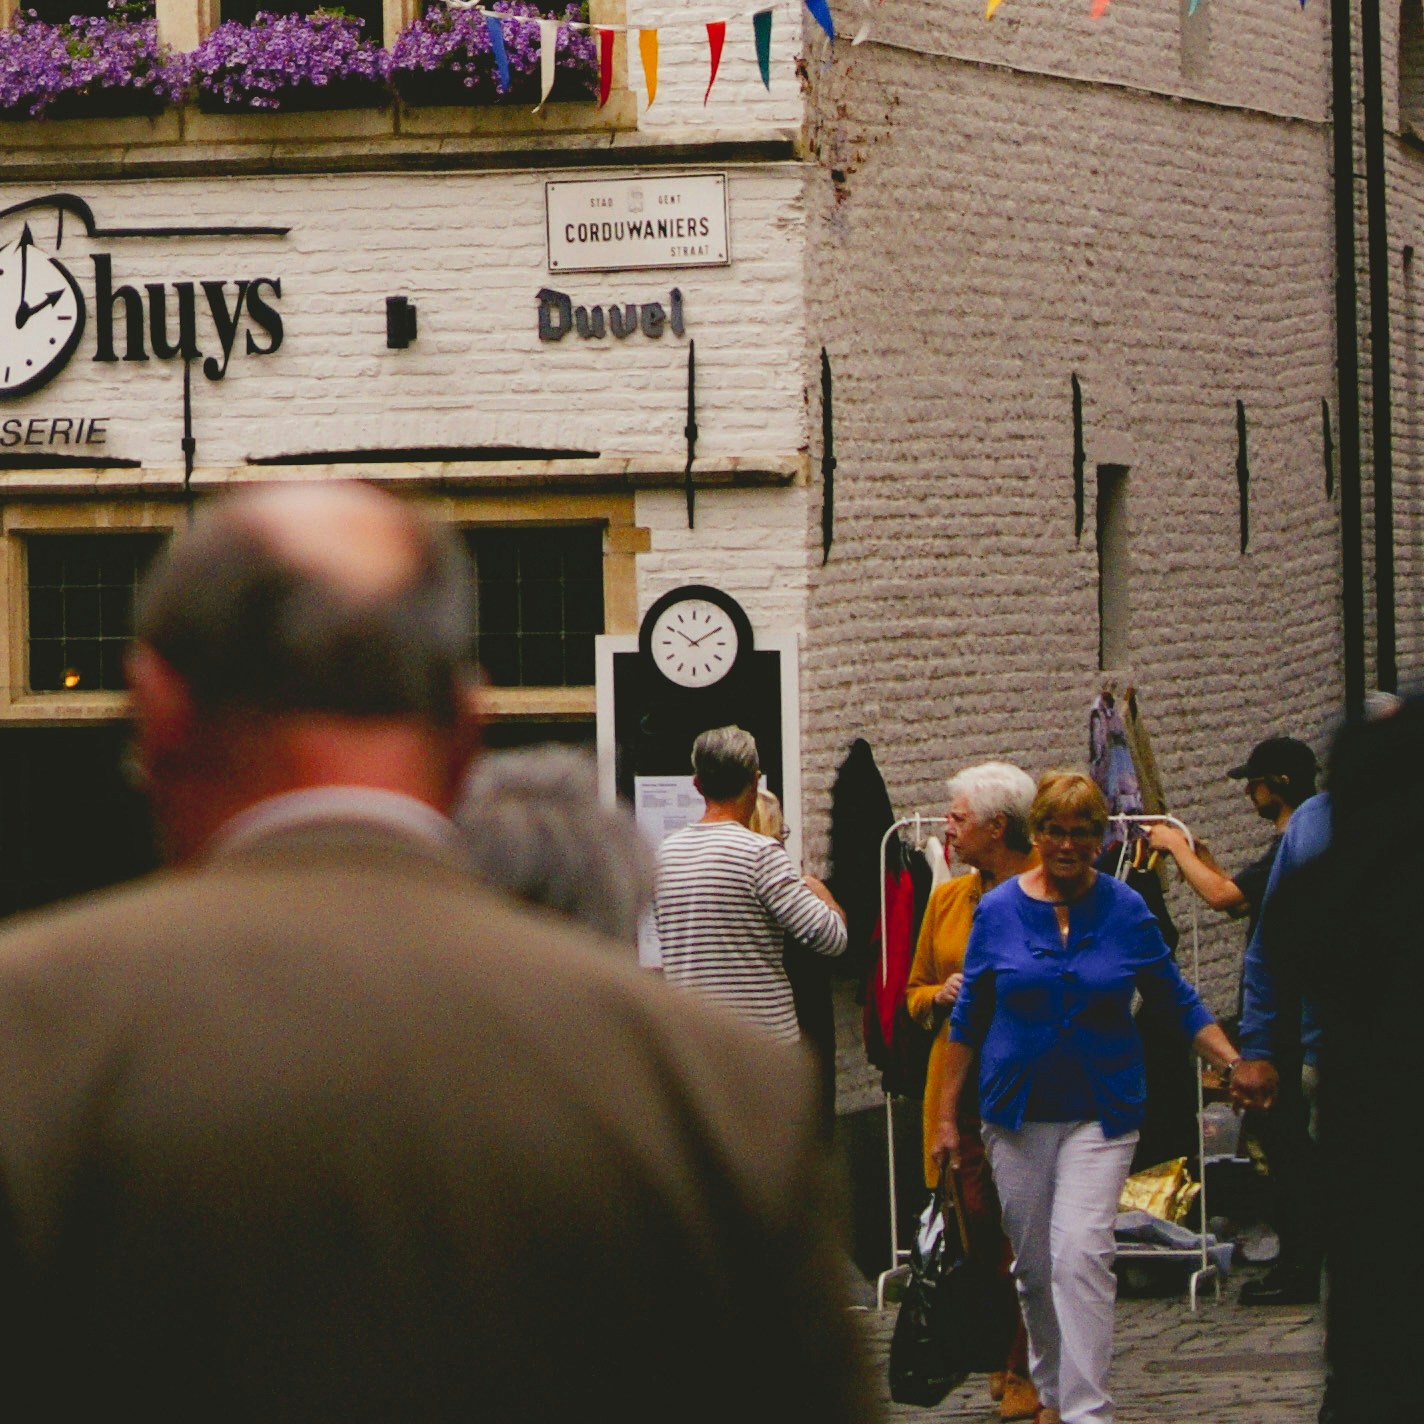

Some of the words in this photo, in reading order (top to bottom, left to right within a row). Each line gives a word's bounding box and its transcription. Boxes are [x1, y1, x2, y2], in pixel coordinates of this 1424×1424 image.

[590, 197, 614, 208] STAD
[658, 194, 682, 205] GENT
[565, 216, 710, 243] CORDUWANIERS
[670, 244, 710, 257] STRAAT
[534, 286, 685, 341] Duvel
